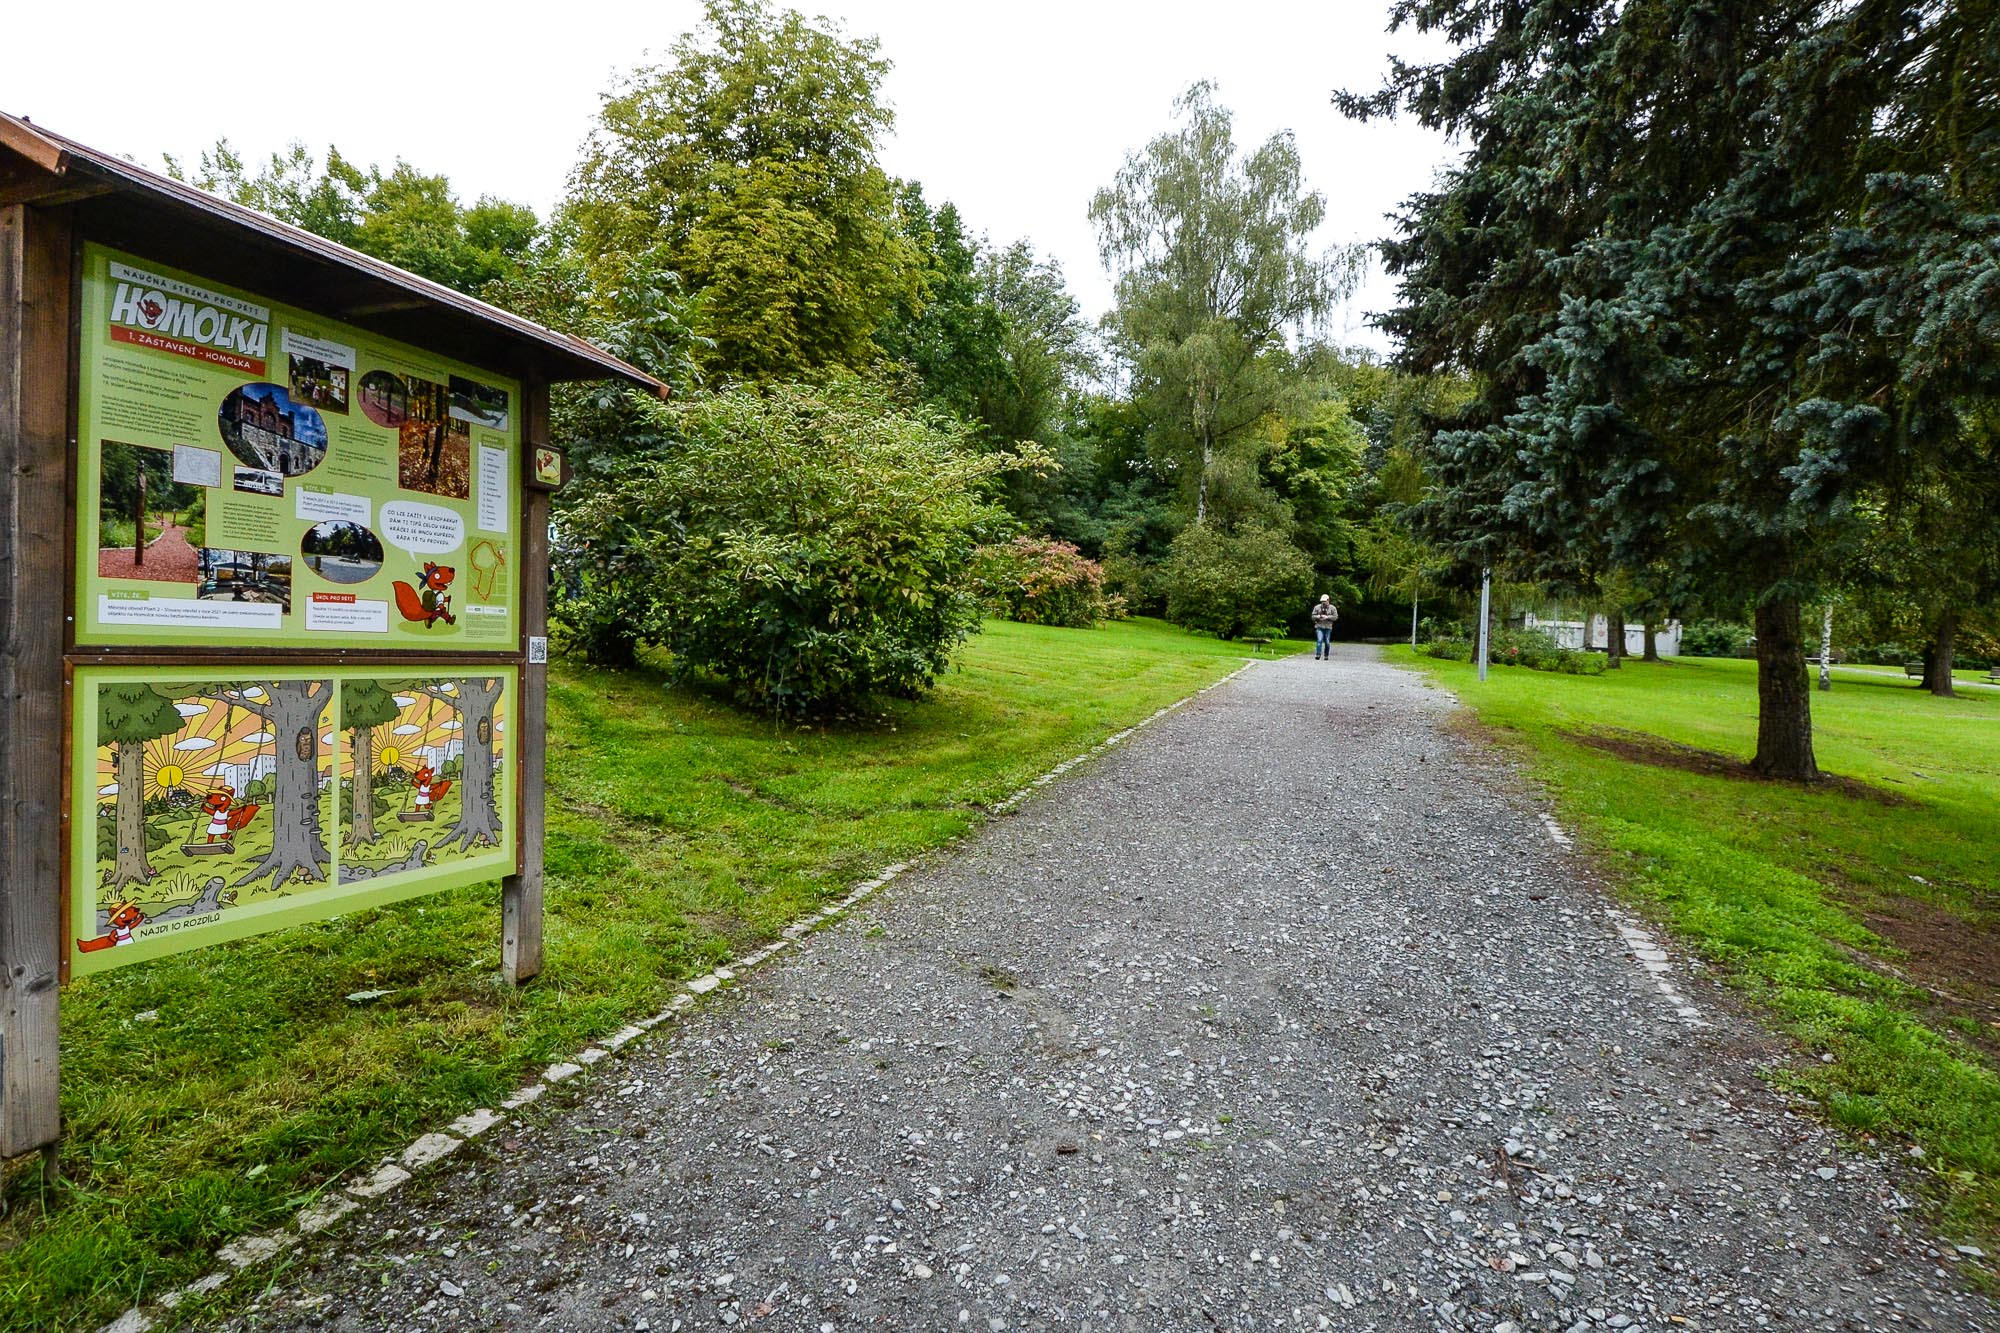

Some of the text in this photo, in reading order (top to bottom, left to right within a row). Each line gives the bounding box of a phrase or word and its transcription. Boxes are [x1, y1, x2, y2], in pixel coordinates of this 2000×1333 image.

[123, 268, 167, 287] NAUČNÁ
[172, 283, 209, 299] STEZKA
[214, 295, 233, 307] PRO
[110, 282, 268, 358] HOMOLKA
[128, 331, 136, 341] 1.
[138, 334, 196, 355] ZASTAVENÍ
[205, 351, 251, 369] HOMOLKA
[140, 924, 169, 938] NAJDI
[183, 912, 220, 929] ROZDÍLŮ
